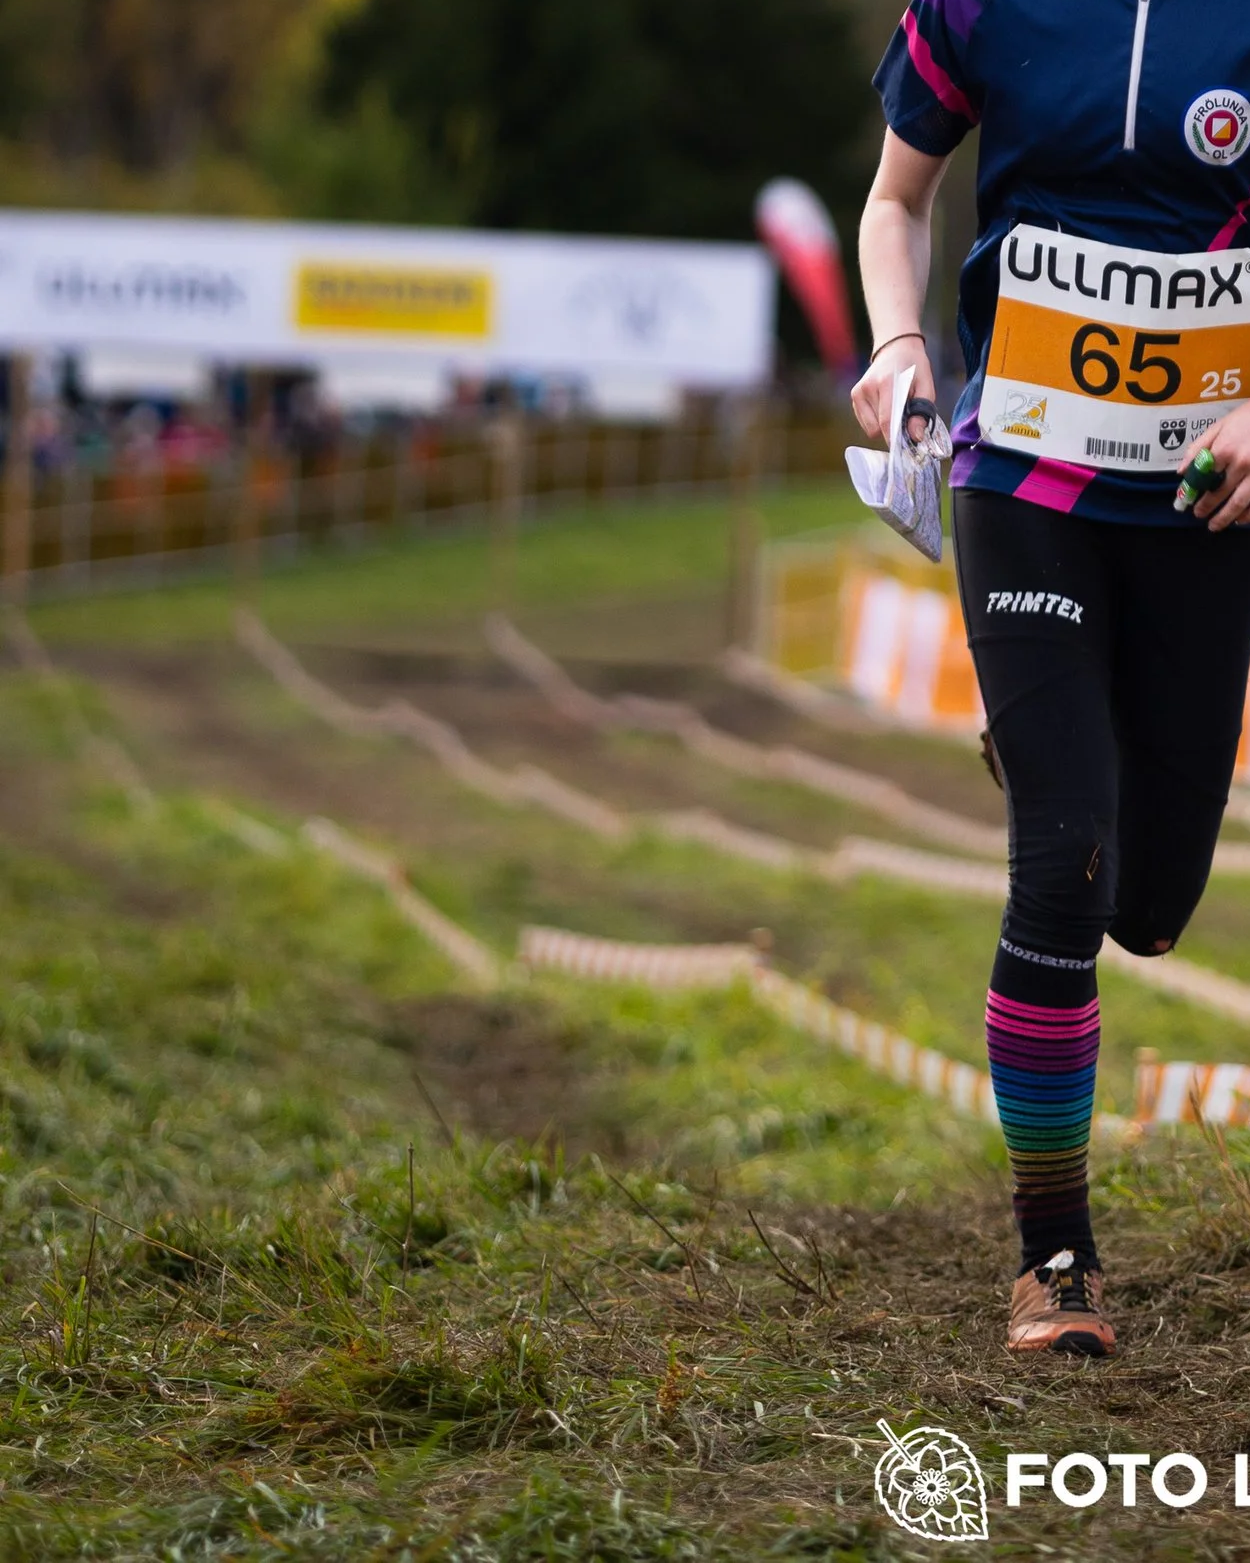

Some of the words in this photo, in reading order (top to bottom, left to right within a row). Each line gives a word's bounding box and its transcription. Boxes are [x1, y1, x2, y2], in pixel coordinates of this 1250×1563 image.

[1194, 97, 1248, 125] FRÖLUNDA
[1212, 149, 1228, 160] OL
[1070, 323, 1182, 404] 65
[1199, 368, 1242, 399] 25
[986, 591, 1084, 625] TRIMTEX
